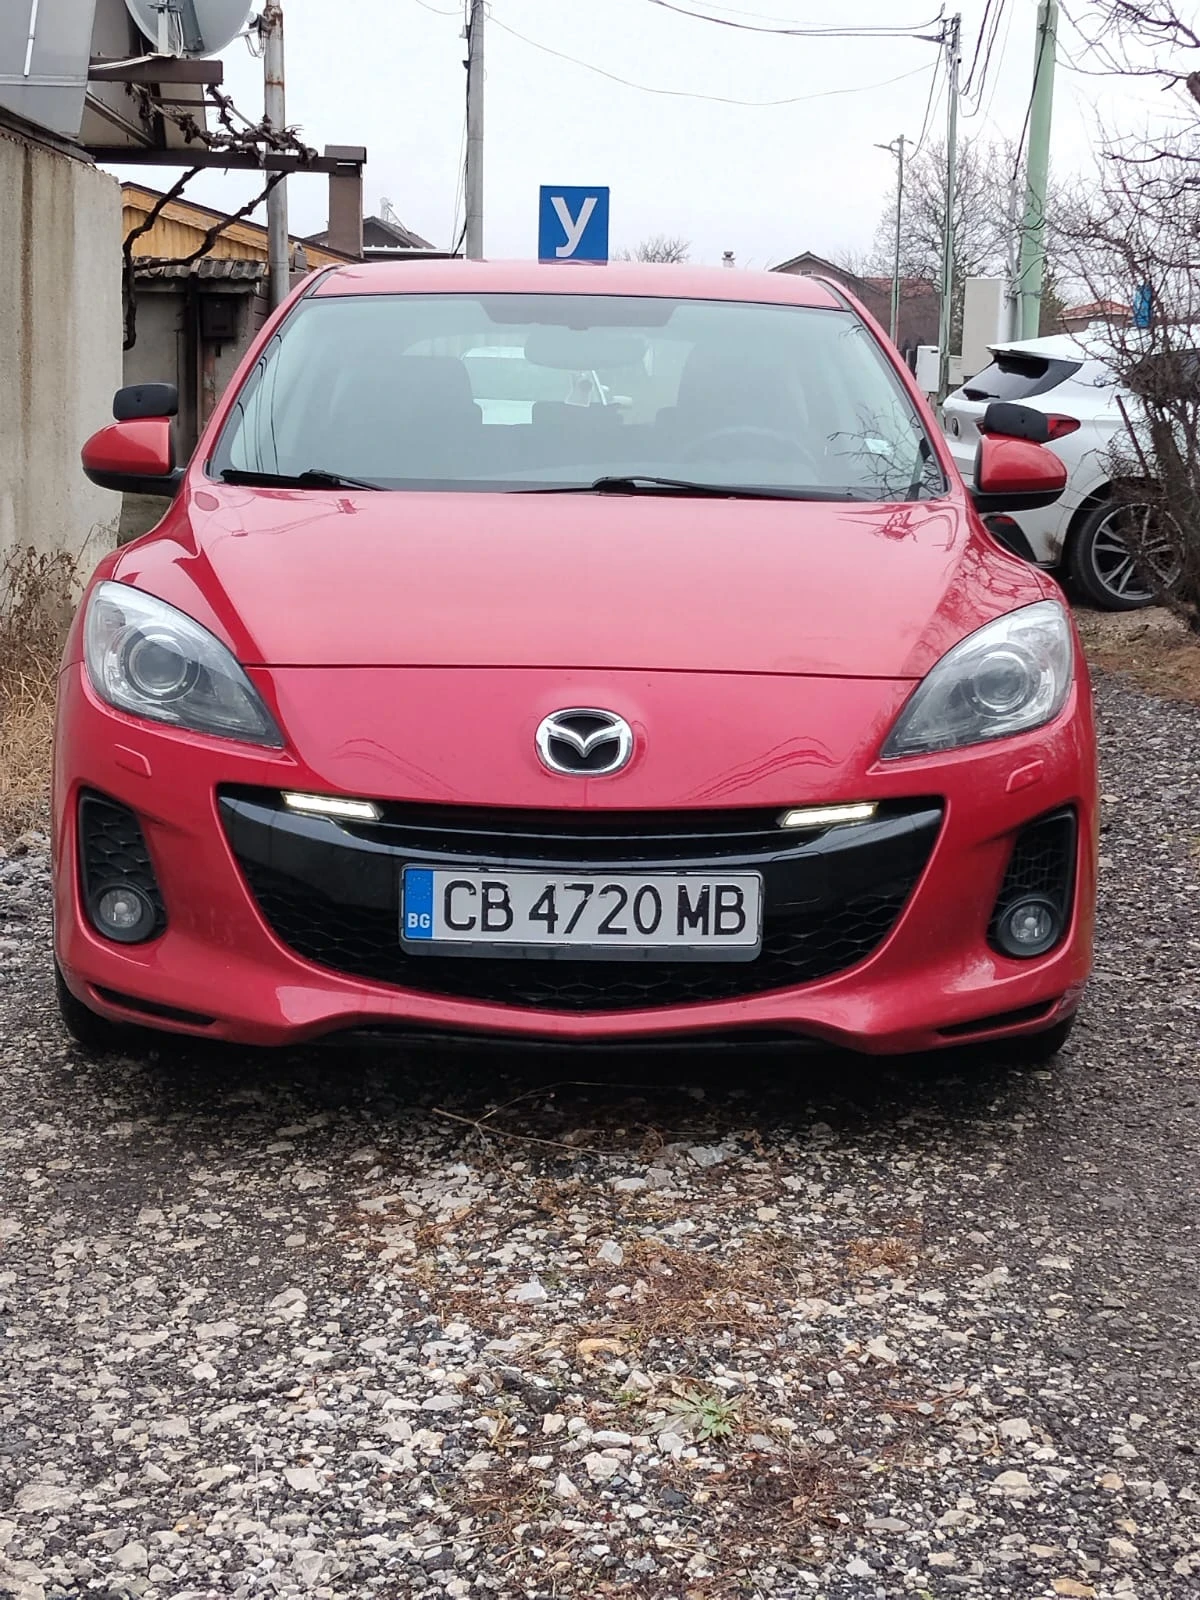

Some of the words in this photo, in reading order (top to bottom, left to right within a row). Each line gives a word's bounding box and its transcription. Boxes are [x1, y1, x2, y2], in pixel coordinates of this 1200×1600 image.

[407, 912, 430, 929] BG
[443, 880, 514, 933] CB
[528, 881, 662, 936] 4720
[676, 884, 747, 936] MB
